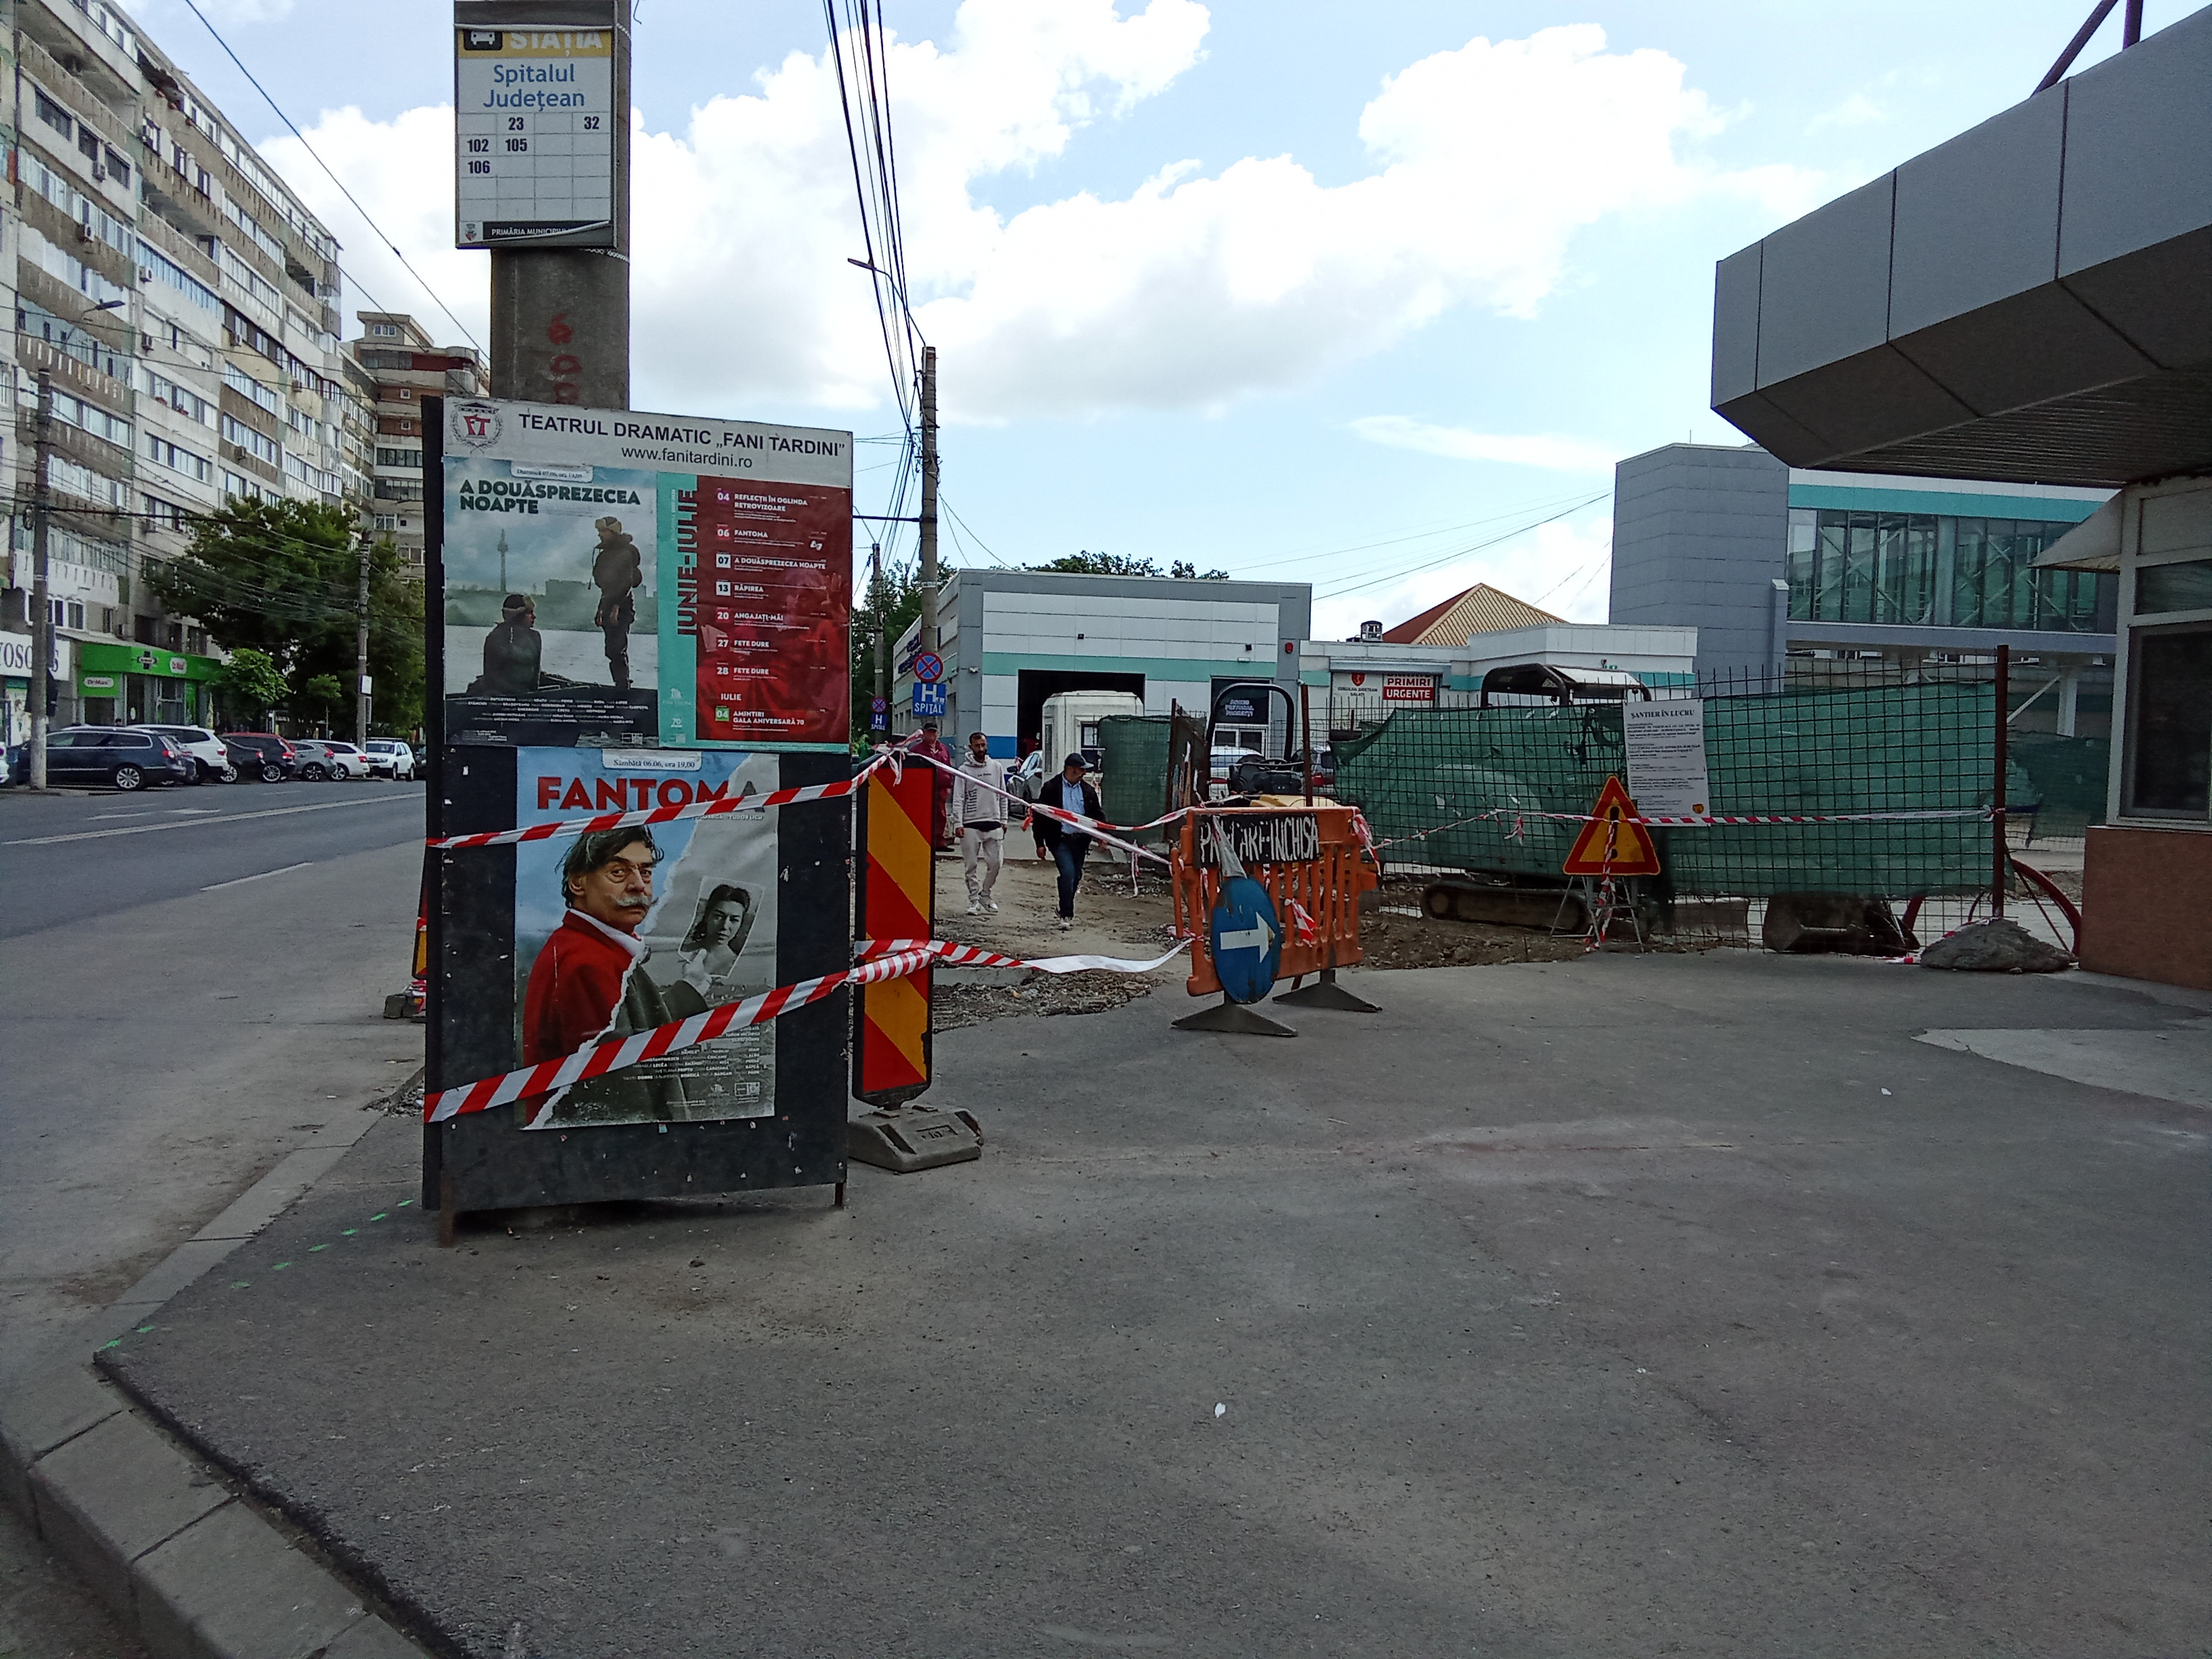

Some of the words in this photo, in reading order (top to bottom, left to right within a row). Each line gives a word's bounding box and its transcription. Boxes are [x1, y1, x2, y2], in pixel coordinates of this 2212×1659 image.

[493, 63, 575, 87] Spitalul
[508, 117, 525, 131] 23
[583, 116, 600, 130] 32
[467, 139, 489, 152] 102
[505, 138, 527, 152] 105
[468, 161, 490, 174] 106
[491, 227, 525, 236] PRIMĂRIA
[518, 413, 609, 436] TEATRUL
[613, 422, 712, 445] DRAMATIC
[621, 447, 753, 468] www.fanitardini.ro
[459, 479, 474, 494] A
[478, 480, 640, 505] DOUĂSPREZECEA
[459, 496, 539, 514] NOAPTE
[717, 492, 730, 501] 04
[778, 497, 808, 506] OGLINDA
[734, 502, 786, 512] RETROVIZOARE
[717, 529, 730, 537] 06
[734, 529, 769, 538] FANTOMA
[718, 556, 730, 565] 07
[799, 561, 826, 569] NOAPTE
[718, 583, 729, 592] 13
[717, 611, 729, 620] 20
[717, 639, 729, 648] 27
[716, 666, 729, 675] 28
[1387, 678, 1431, 687] PRIMIRI
[720, 693, 742, 701] IULIE
[922, 684, 937, 703] H
[716, 710, 729, 718] 04
[733, 710, 764, 718] AMINTIRI
[914, 702, 943, 714] SPITAL
[875, 714, 882, 724] H
